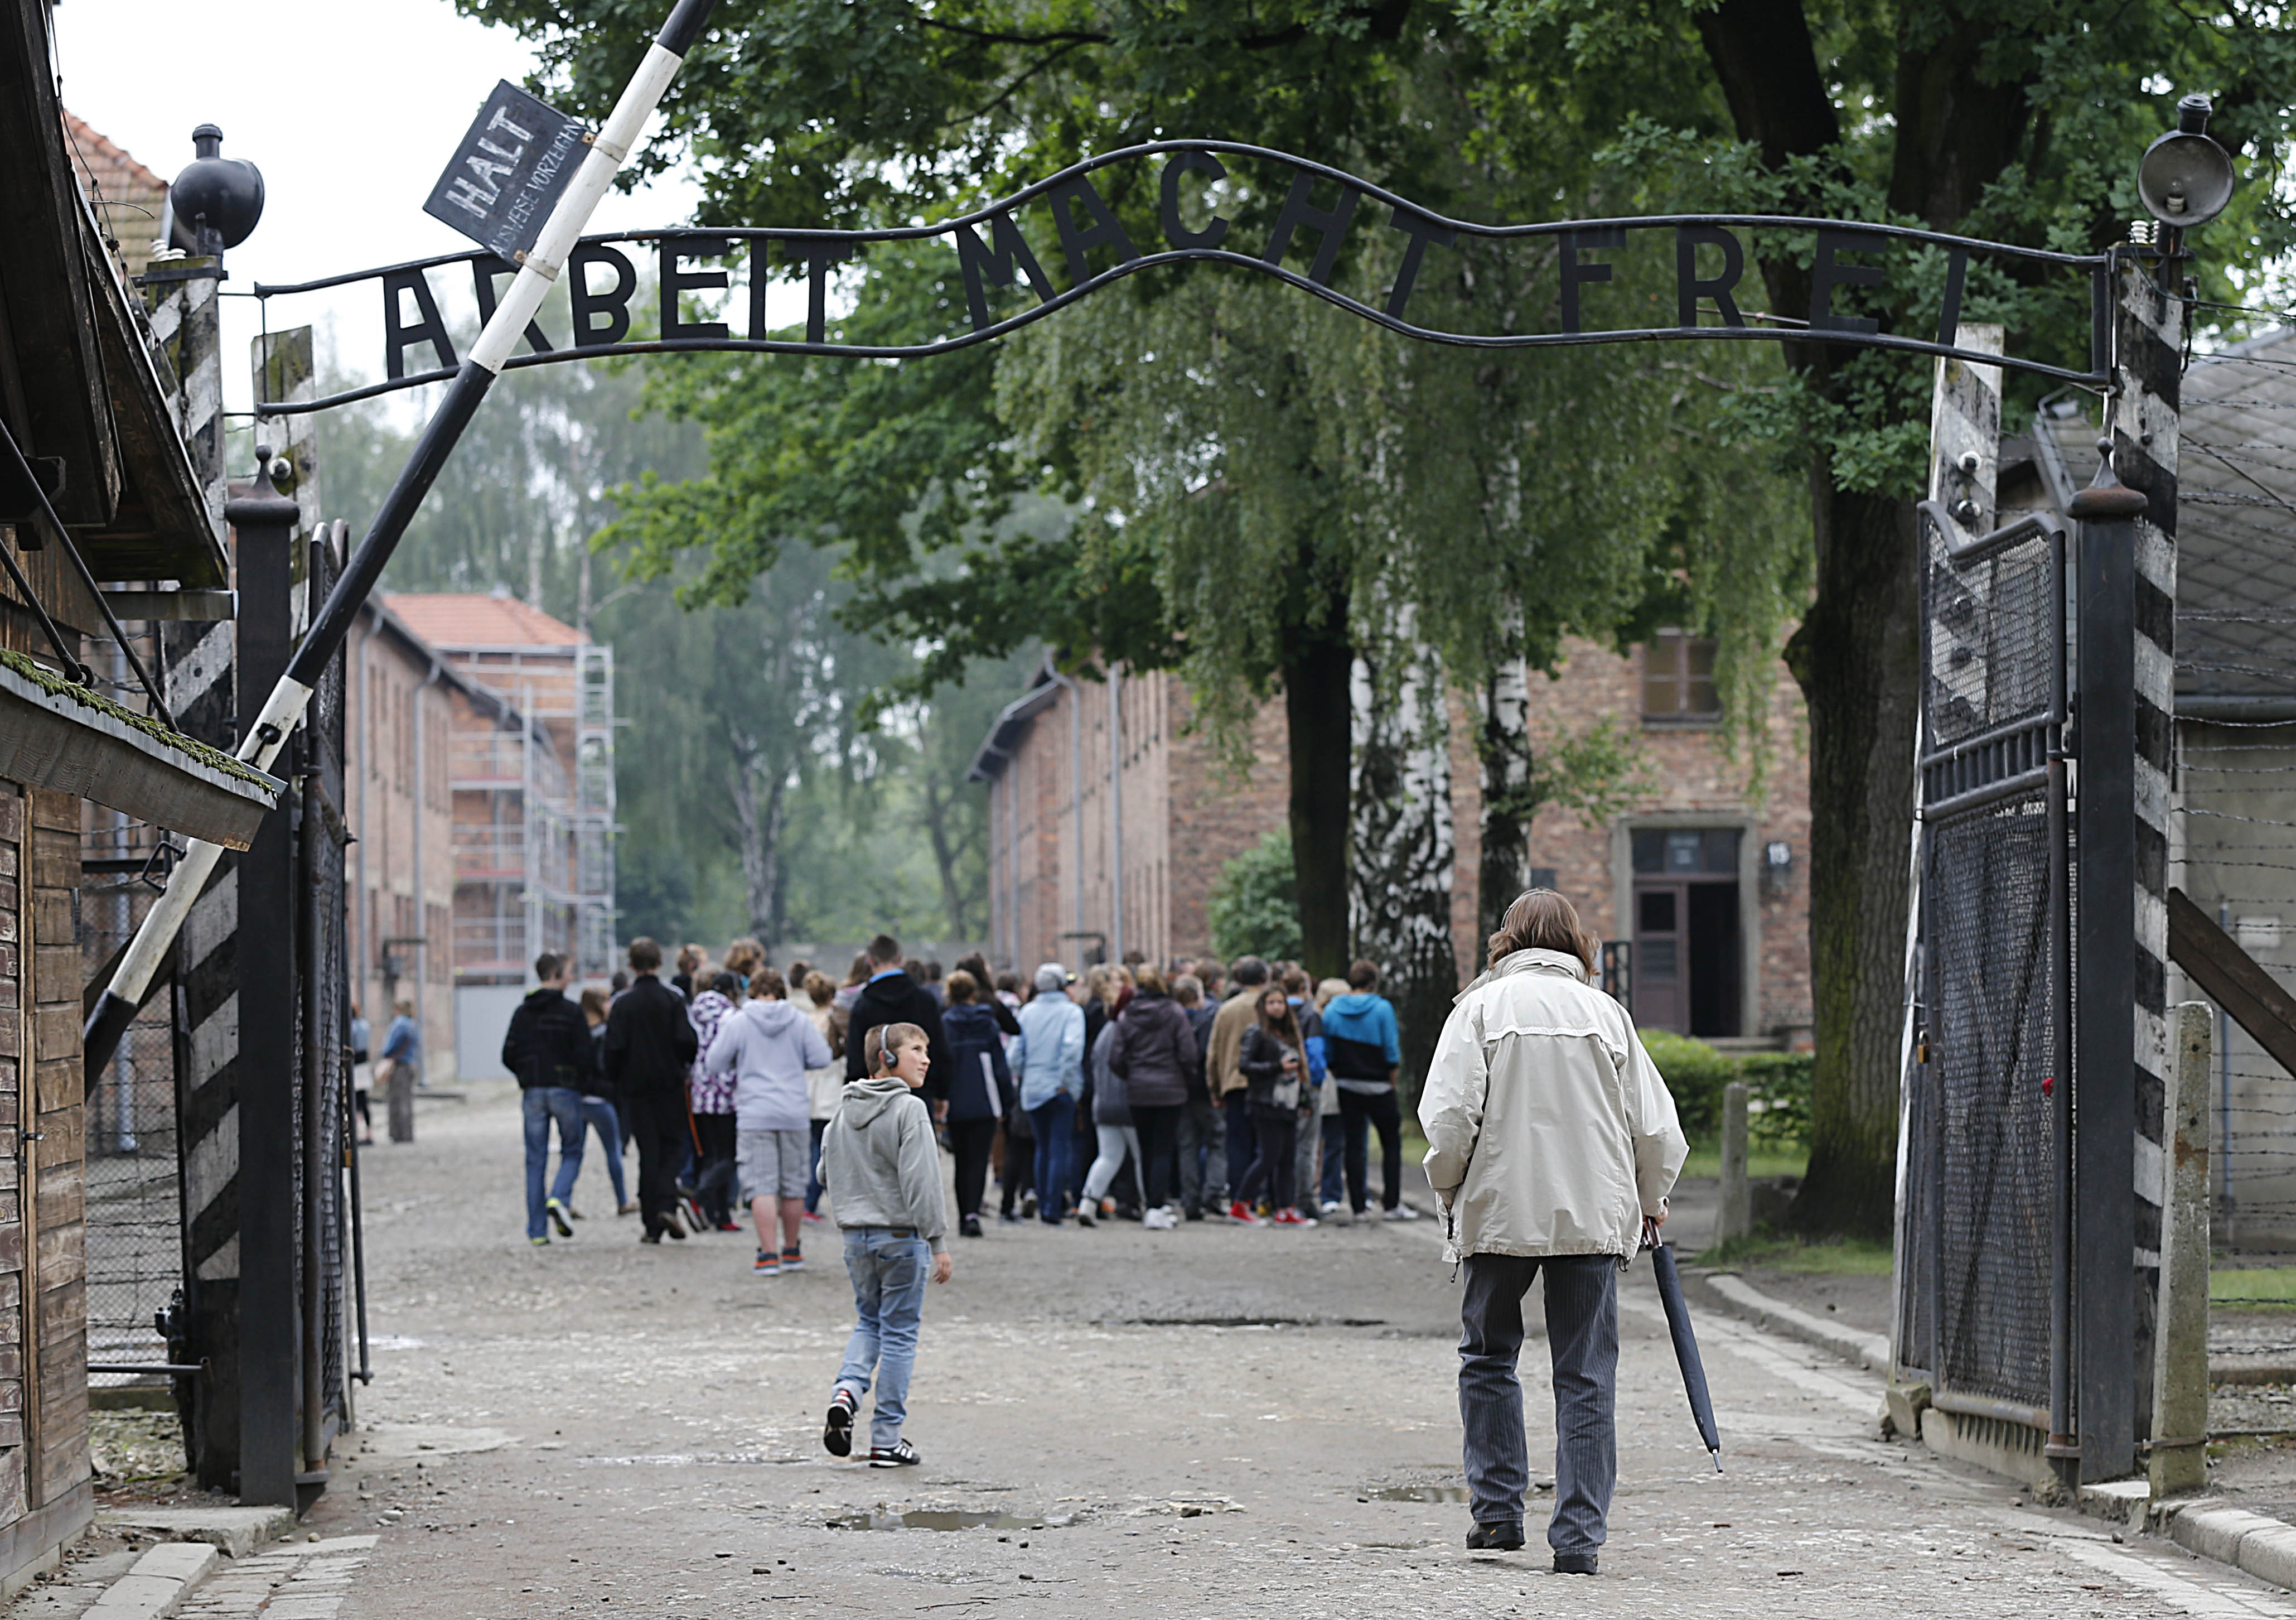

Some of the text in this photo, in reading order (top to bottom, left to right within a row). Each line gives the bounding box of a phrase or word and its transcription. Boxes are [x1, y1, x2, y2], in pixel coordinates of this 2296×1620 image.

[444, 105, 534, 220] HALT
[489, 186, 541, 258] AUSWEISE
[955, 148, 1457, 331] MACHT
[1559, 225, 1968, 347] FREI
